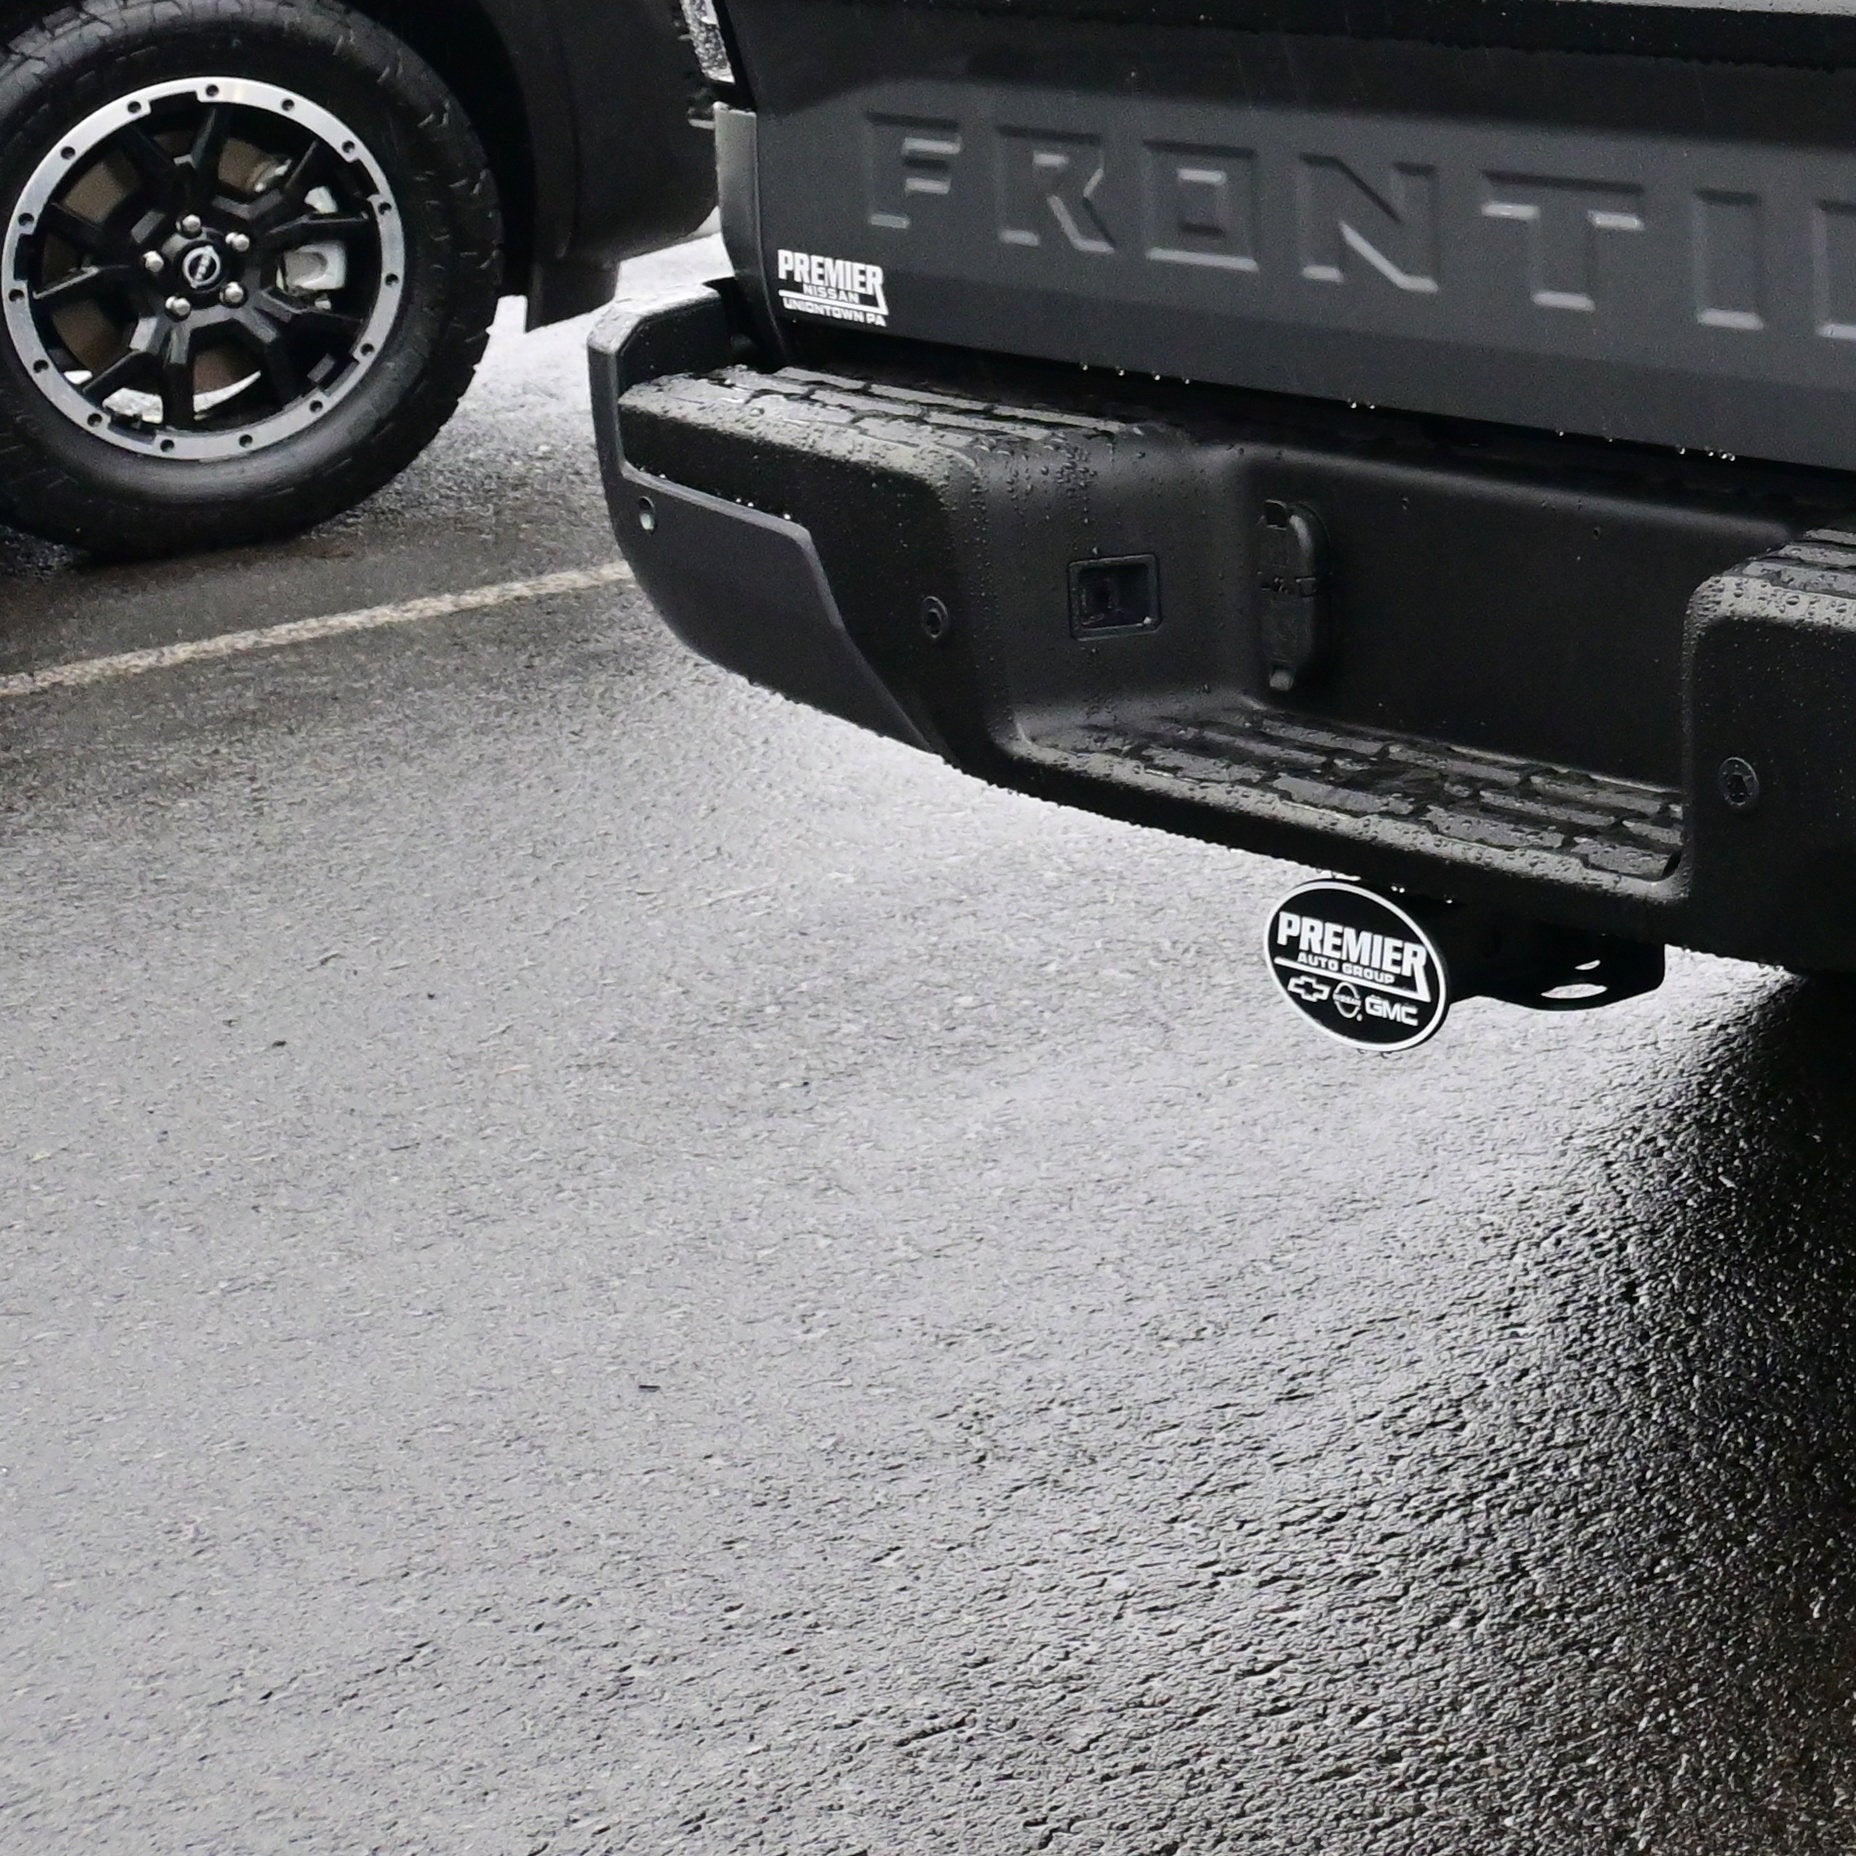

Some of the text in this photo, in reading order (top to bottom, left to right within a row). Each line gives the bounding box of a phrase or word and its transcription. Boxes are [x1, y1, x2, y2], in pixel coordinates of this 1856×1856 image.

[777, 248, 884, 296] PREMIER
[803, 283, 860, 304] NISSAN
[782, 297, 887, 327] UNIONTOWN PA
[1277, 911, 1427, 977] PREMIER
[1297, 952, 1396, 985] AUTO GROUP
[1365, 995, 1418, 1026] GMC
